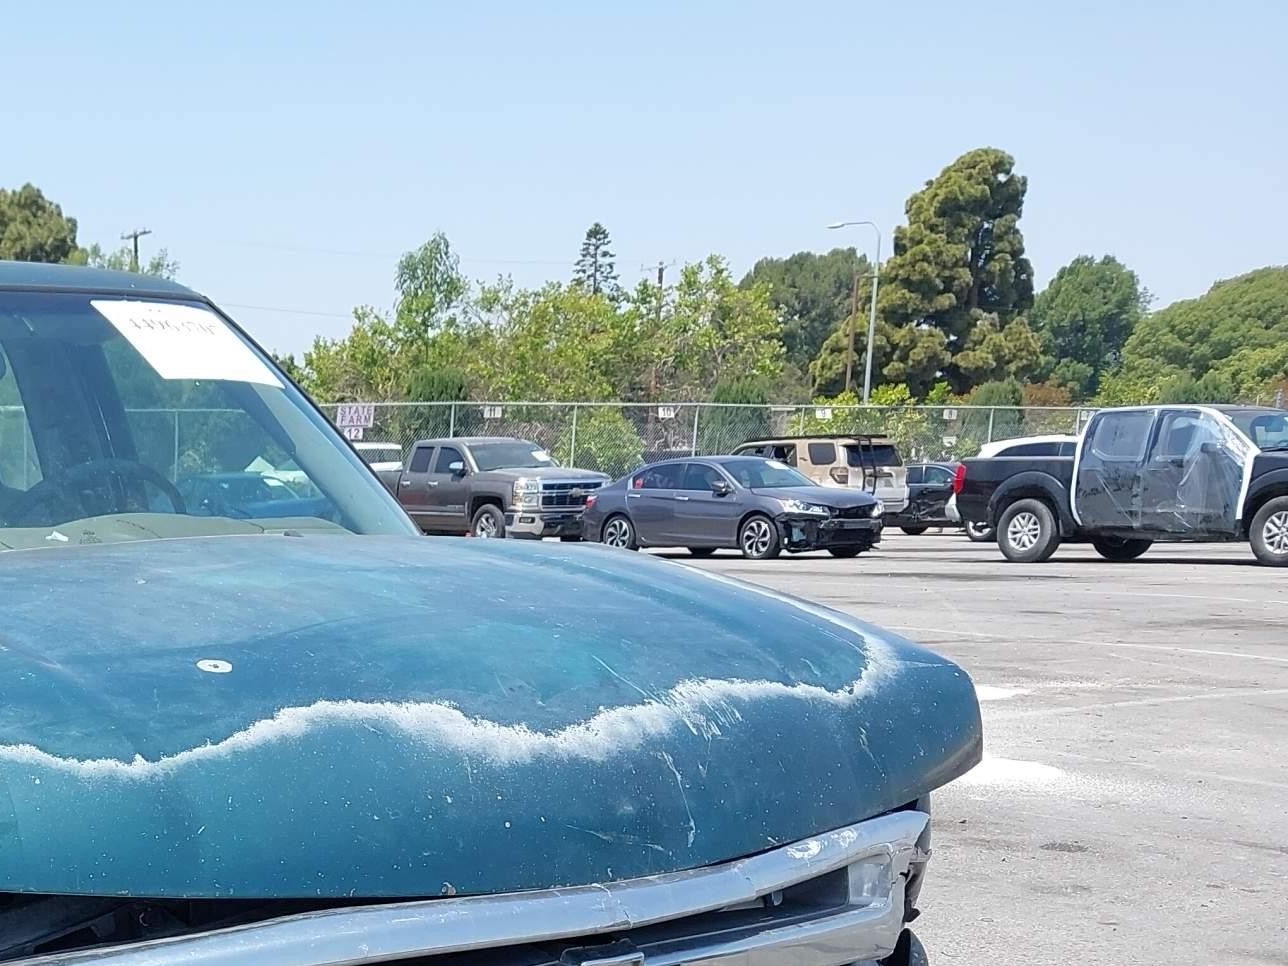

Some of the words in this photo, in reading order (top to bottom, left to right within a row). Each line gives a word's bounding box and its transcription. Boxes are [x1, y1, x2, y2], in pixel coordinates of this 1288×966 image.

[340, 406, 372, 416] STATE
[662, 407, 672, 417] 10
[340, 415, 371, 425] FARM
[347, 428, 360, 439] 12
